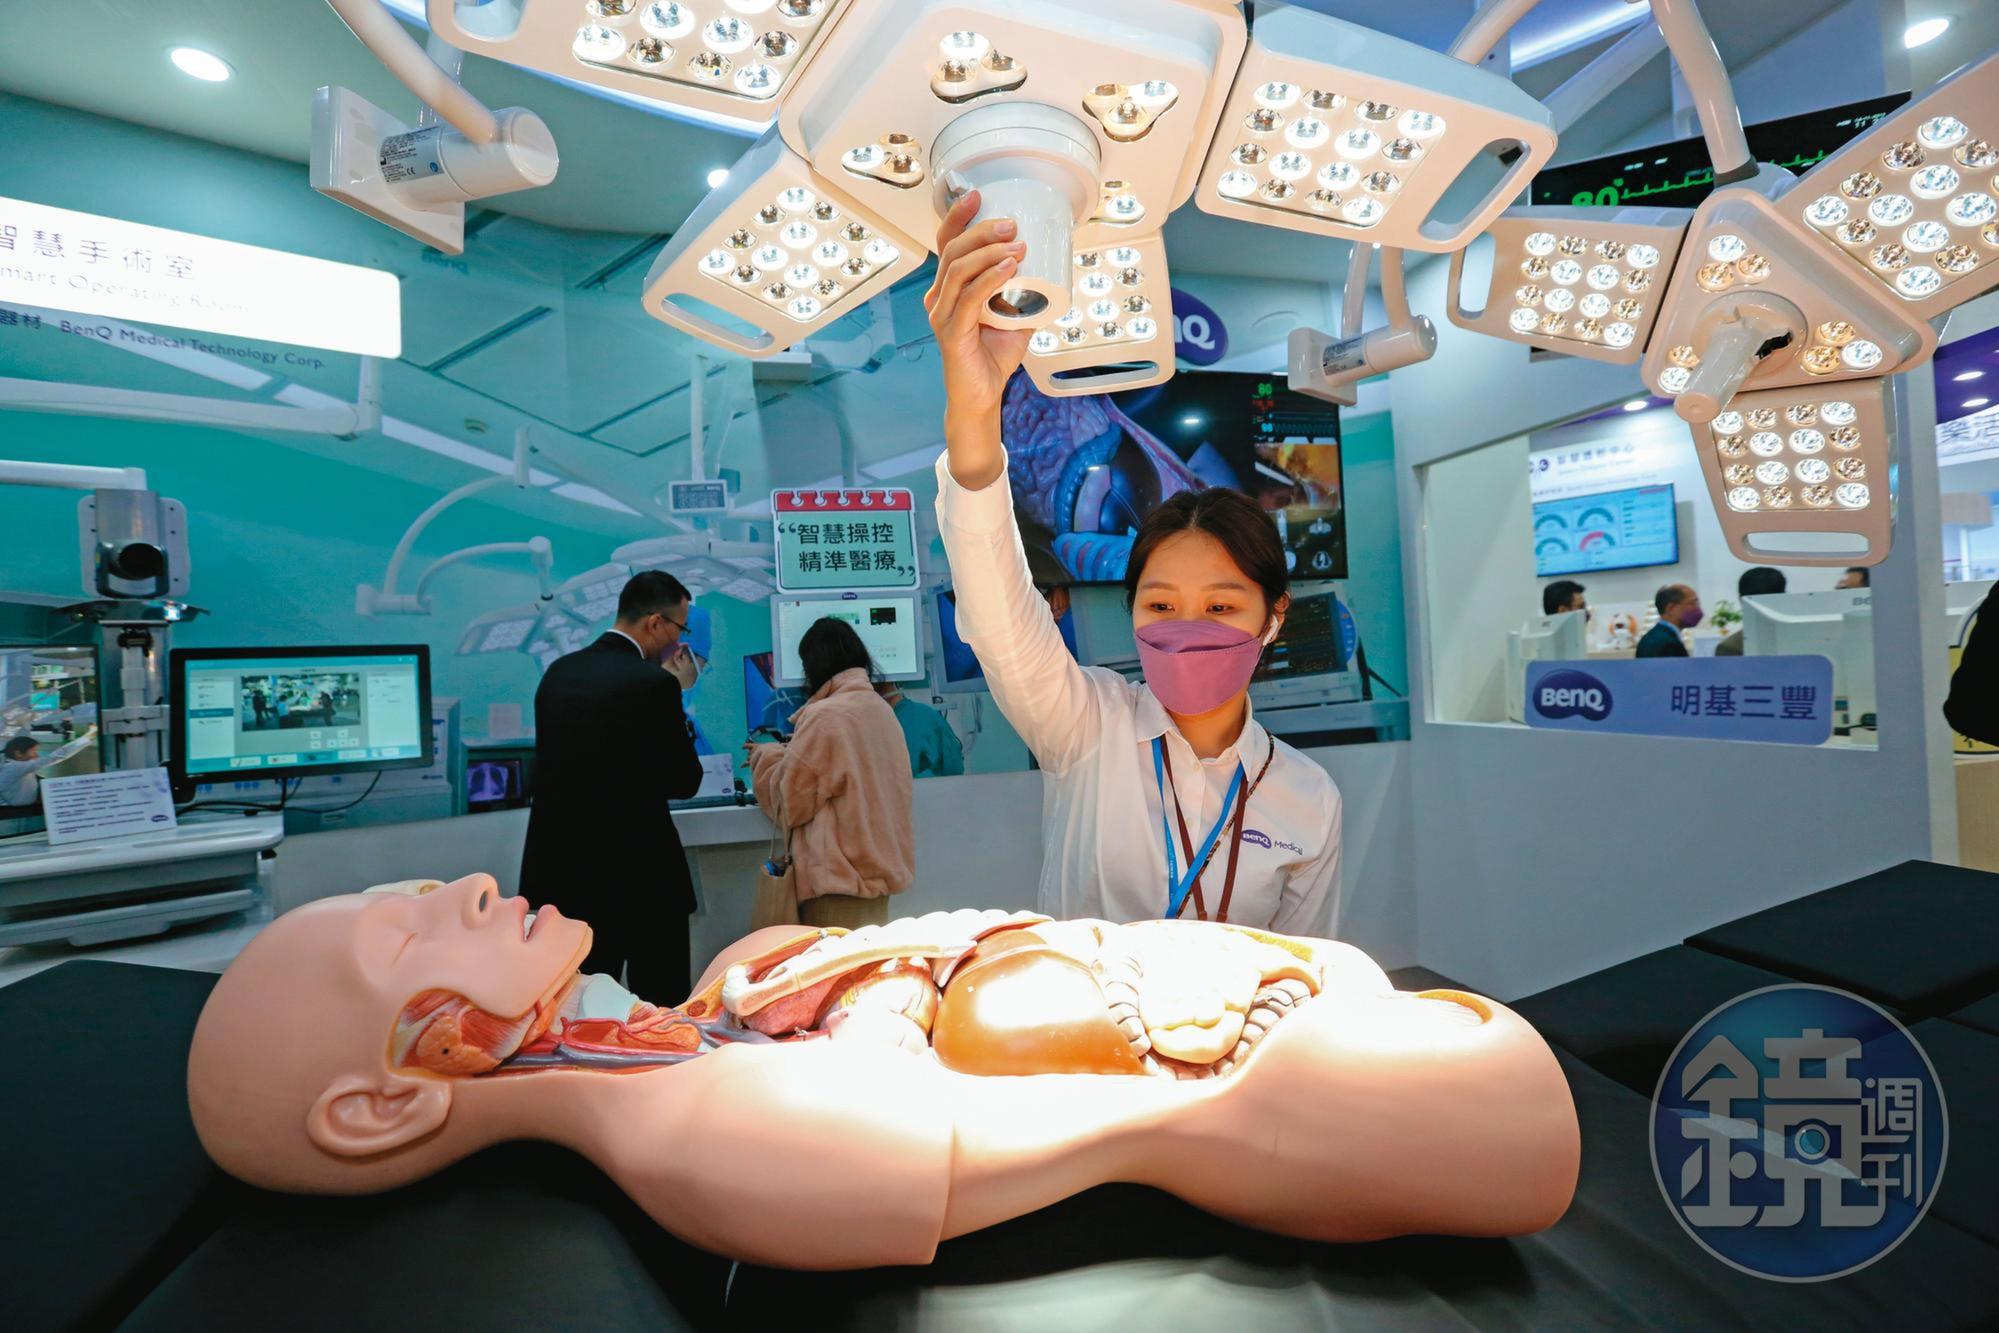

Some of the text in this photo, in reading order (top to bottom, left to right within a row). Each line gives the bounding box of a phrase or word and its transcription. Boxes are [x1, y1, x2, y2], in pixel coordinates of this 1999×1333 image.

[0, 266, 57, 286] mart
[60, 319, 113, 341] BenQ
[119, 328, 186, 350] Medical
[188, 338, 279, 365] Technology
[284, 351, 327, 370] Corp.
[1541, 684, 1817, 721] BenQ 明基三豐
[1242, 832, 1303, 856] BenQ Medical
